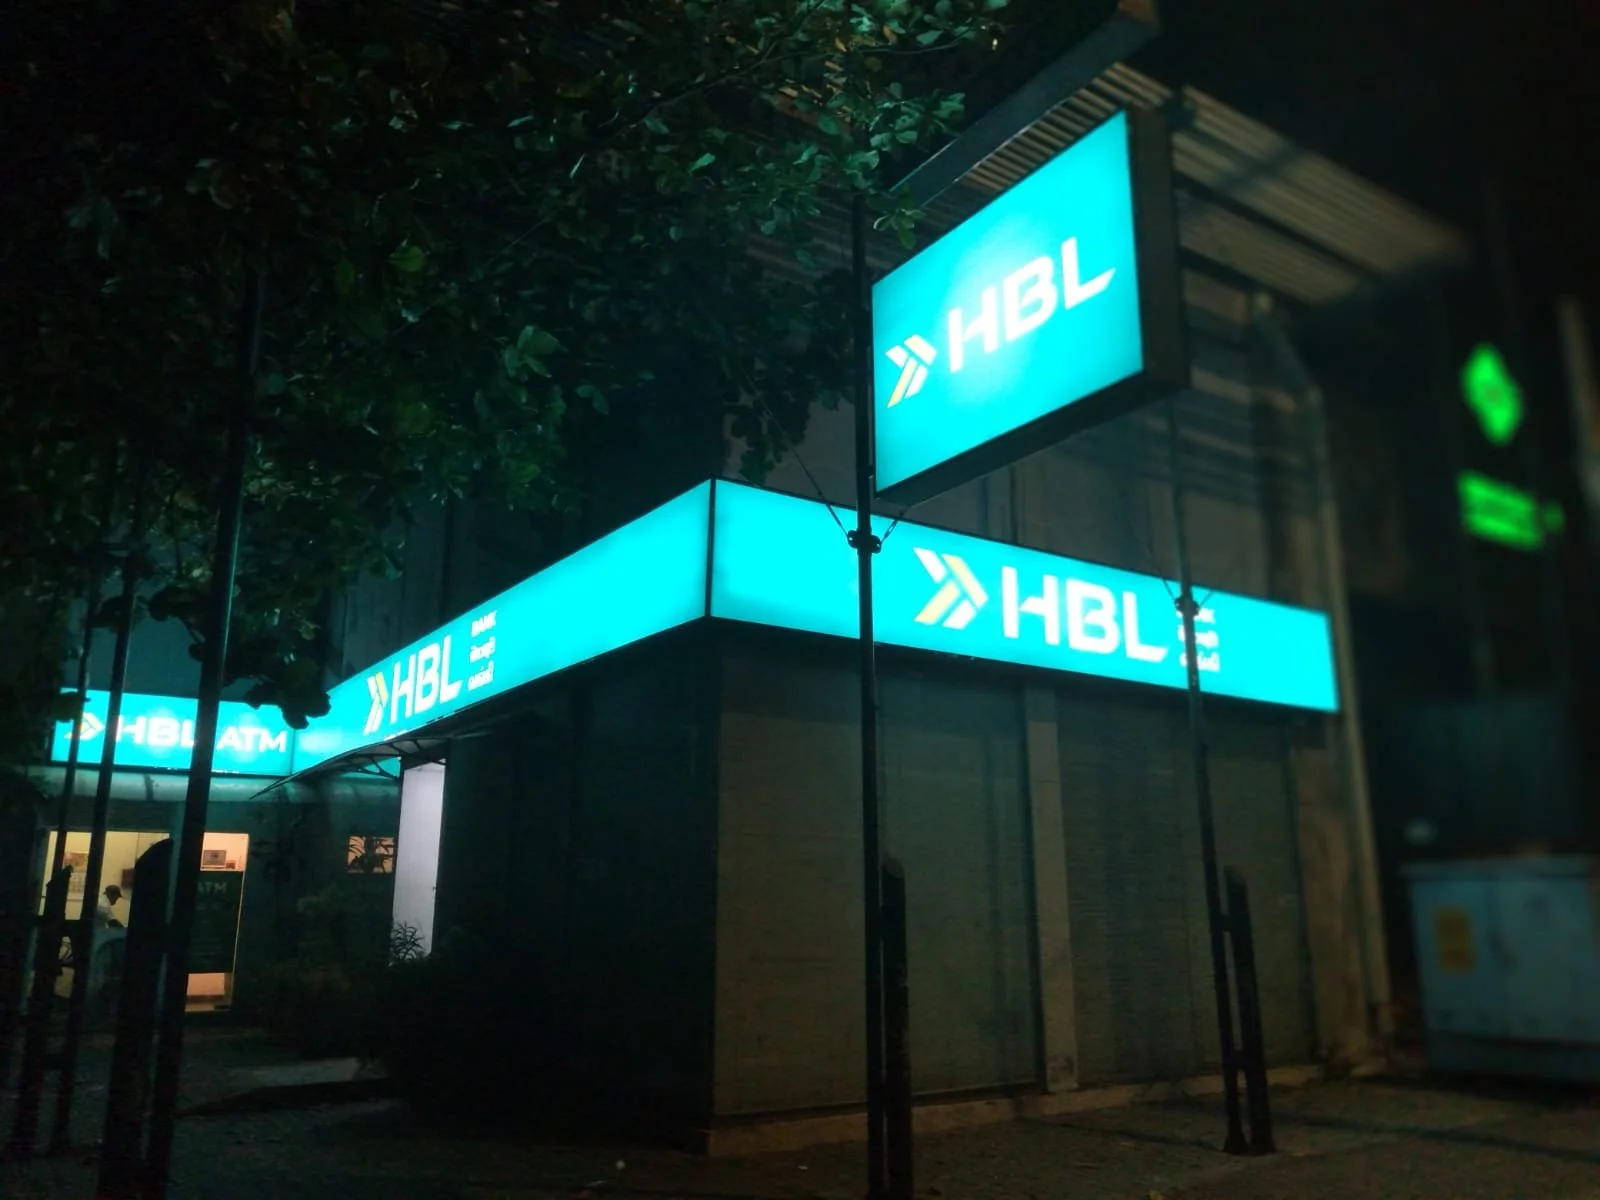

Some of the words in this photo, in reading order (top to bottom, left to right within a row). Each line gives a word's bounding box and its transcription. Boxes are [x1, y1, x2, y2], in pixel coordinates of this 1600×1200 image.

[947, 236, 1117, 373] HBL
[1002, 565, 1168, 663] HBL
[390, 635, 463, 725] HBL
[115, 714, 195, 748] HBL
[216, 725, 288, 753] ATM
